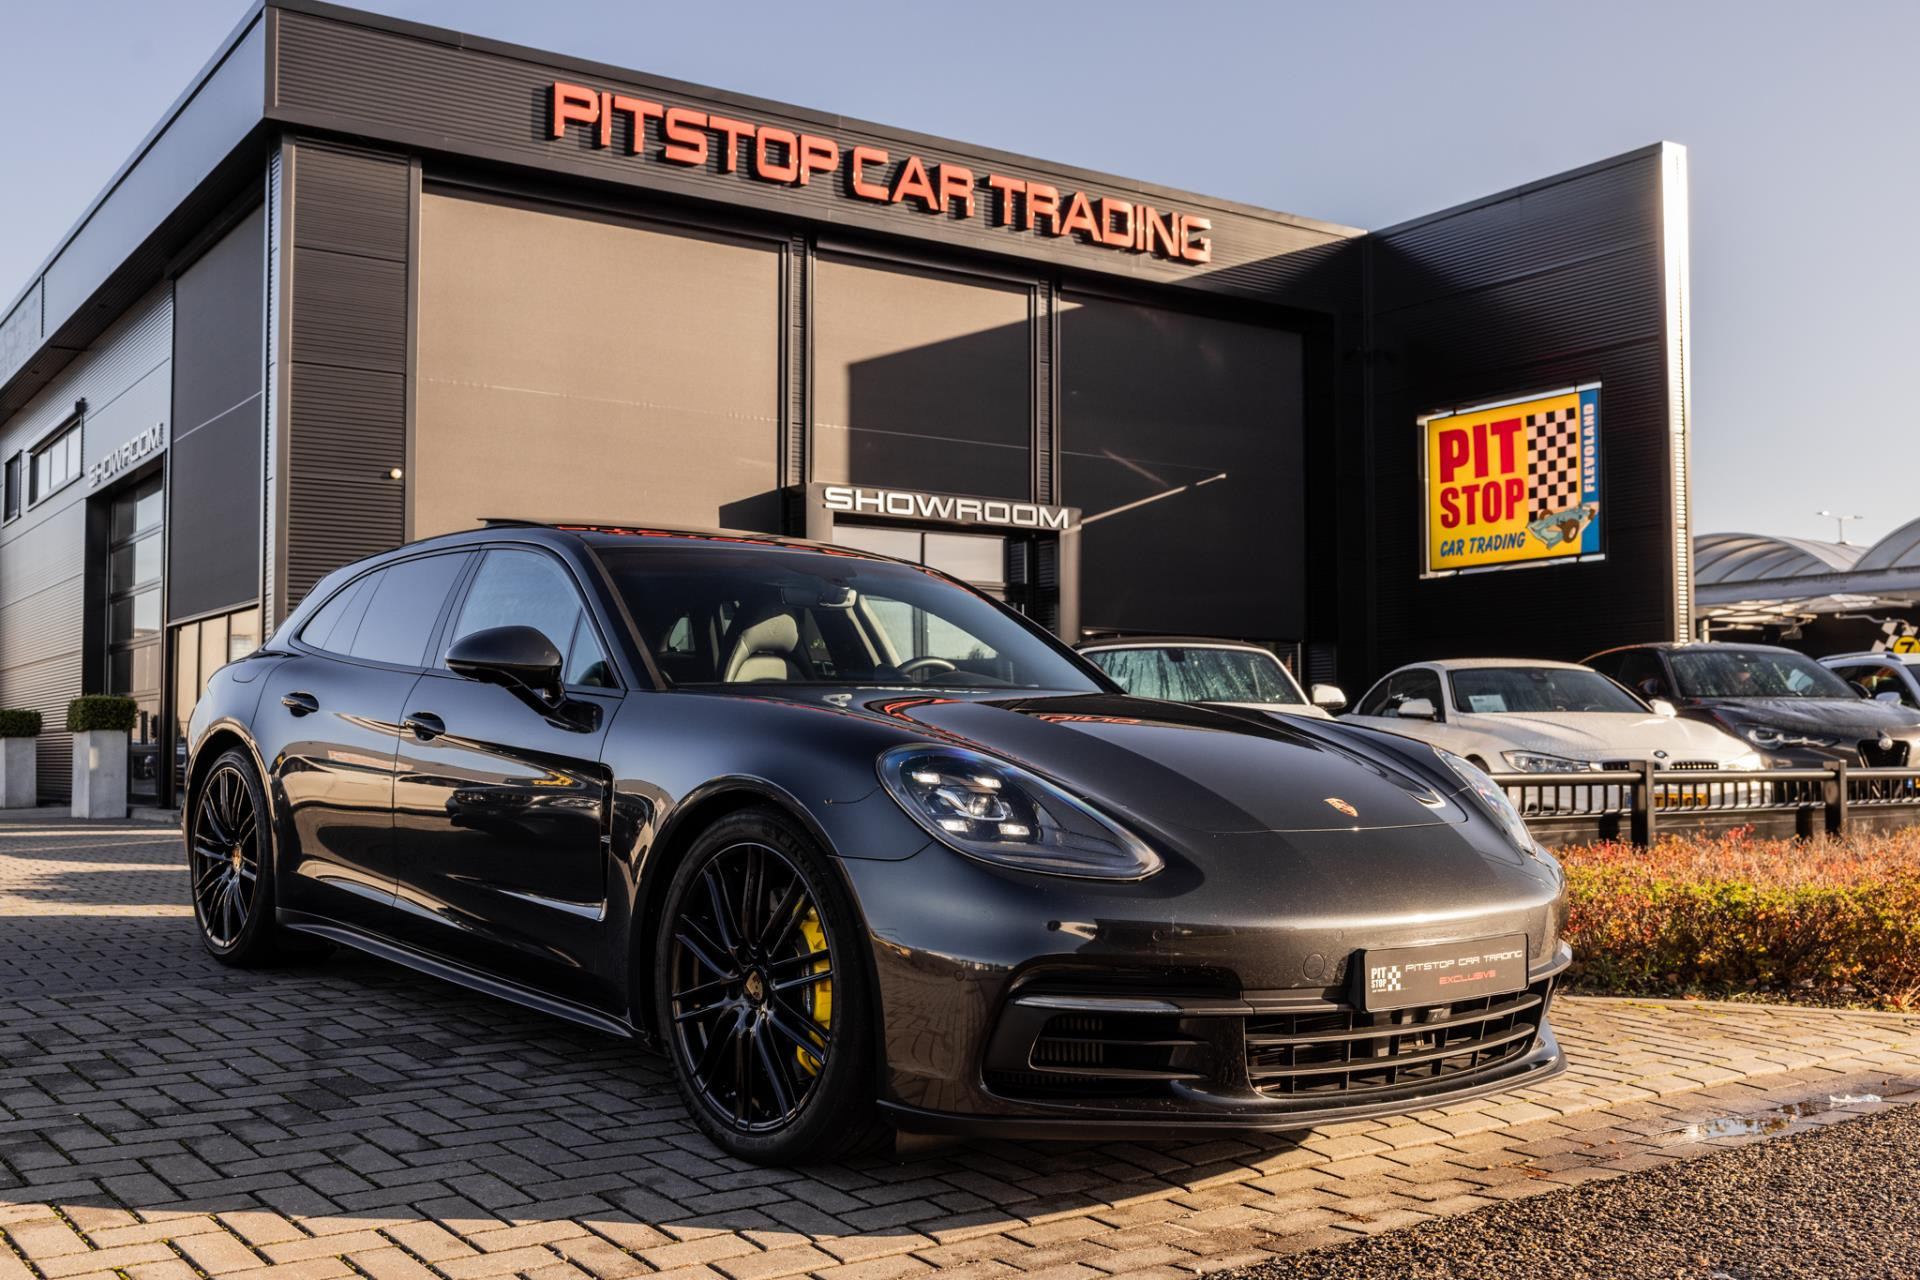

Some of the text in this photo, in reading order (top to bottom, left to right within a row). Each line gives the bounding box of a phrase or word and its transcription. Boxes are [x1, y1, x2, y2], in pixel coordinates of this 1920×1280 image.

[554, 81, 1212, 264] PITSTOP CAR TRADING
[87, 421, 164, 489] SHOWROOM
[1438, 417, 1523, 484] PIT
[1583, 403, 1595, 493] FLEVOLAND
[824, 486, 1069, 529] SHOWROOM
[1440, 477, 1525, 529] STOP
[1440, 532, 1526, 557] CAR TRADING
[1371, 966, 1387, 980] PIT
[1405, 950, 1523, 973] PITSTOP CAR TRADING
[1439, 969, 1497, 985] EXCLUSIVE
[1371, 979, 1387, 989] STOP
